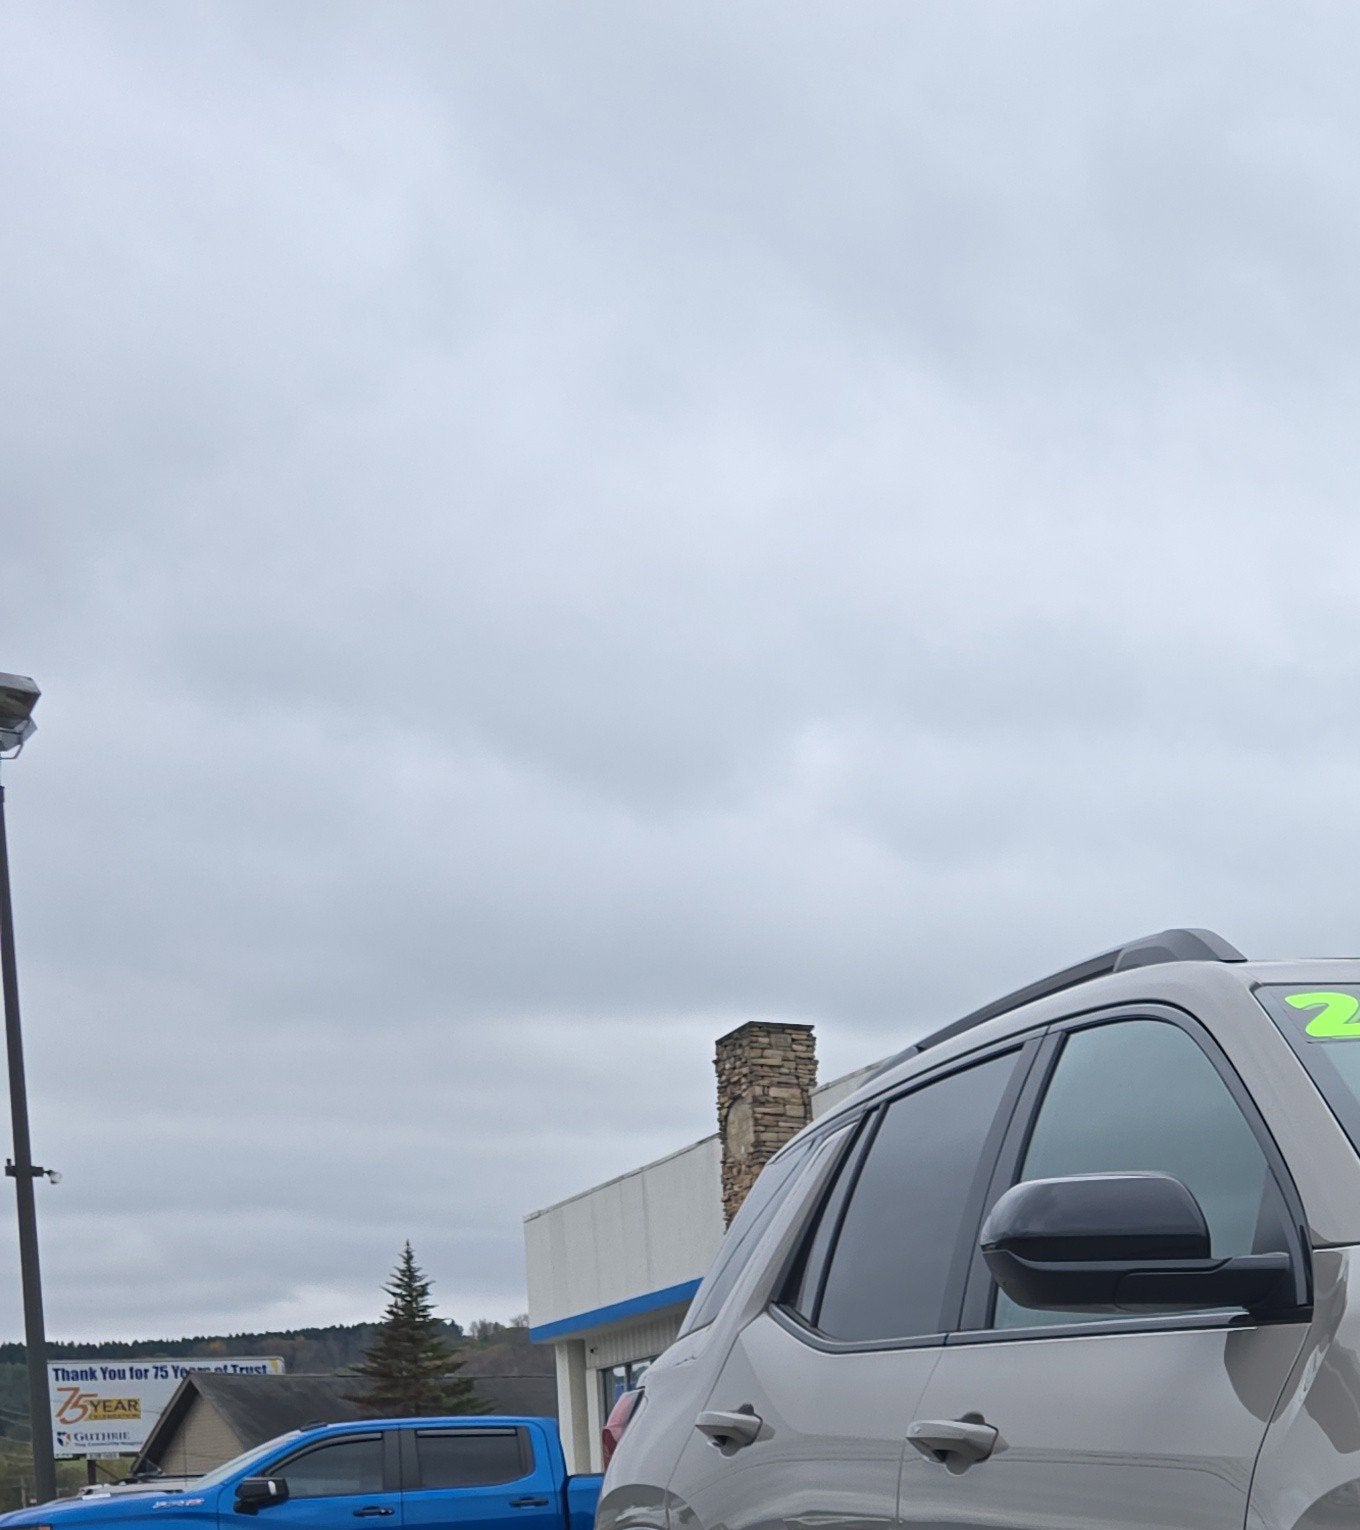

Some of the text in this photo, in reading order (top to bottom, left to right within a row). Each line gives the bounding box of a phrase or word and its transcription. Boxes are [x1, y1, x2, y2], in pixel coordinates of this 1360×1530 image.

[52, 1366, 98, 1382] Thank
[100, 1366, 127, 1381] You
[129, 1366, 150, 1380] for
[152, 1365, 169, 1380] 75
[230, 1364, 268, 1375] Trust
[55, 1386, 139, 1426] 75 YEAR
